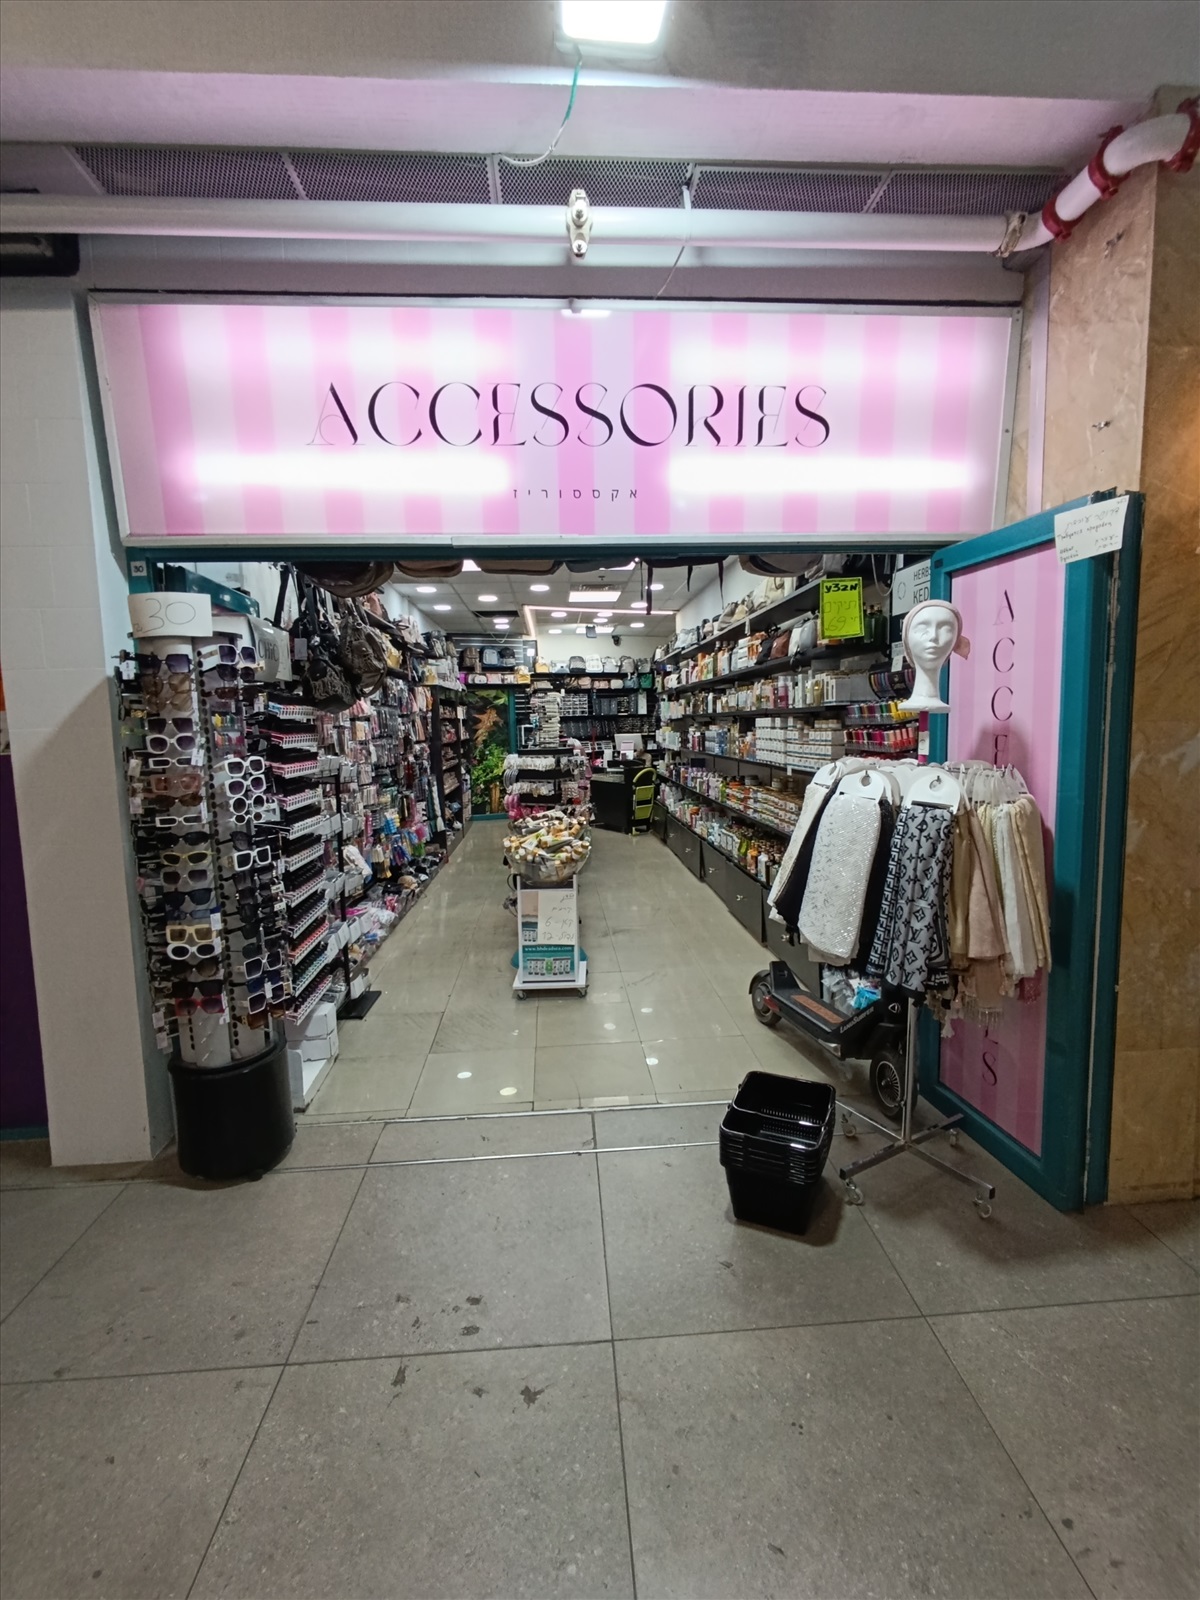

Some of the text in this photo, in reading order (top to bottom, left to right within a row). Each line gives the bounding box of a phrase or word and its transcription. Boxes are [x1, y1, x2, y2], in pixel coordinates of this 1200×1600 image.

[306, 382, 830, 448] ACCESSORIES
[513, 489, 638, 501] אקססוריז
[133, 565, 144, 573] 30
[825, 583, 859, 594] מבצע
[143, 598, 196, 634] 30
